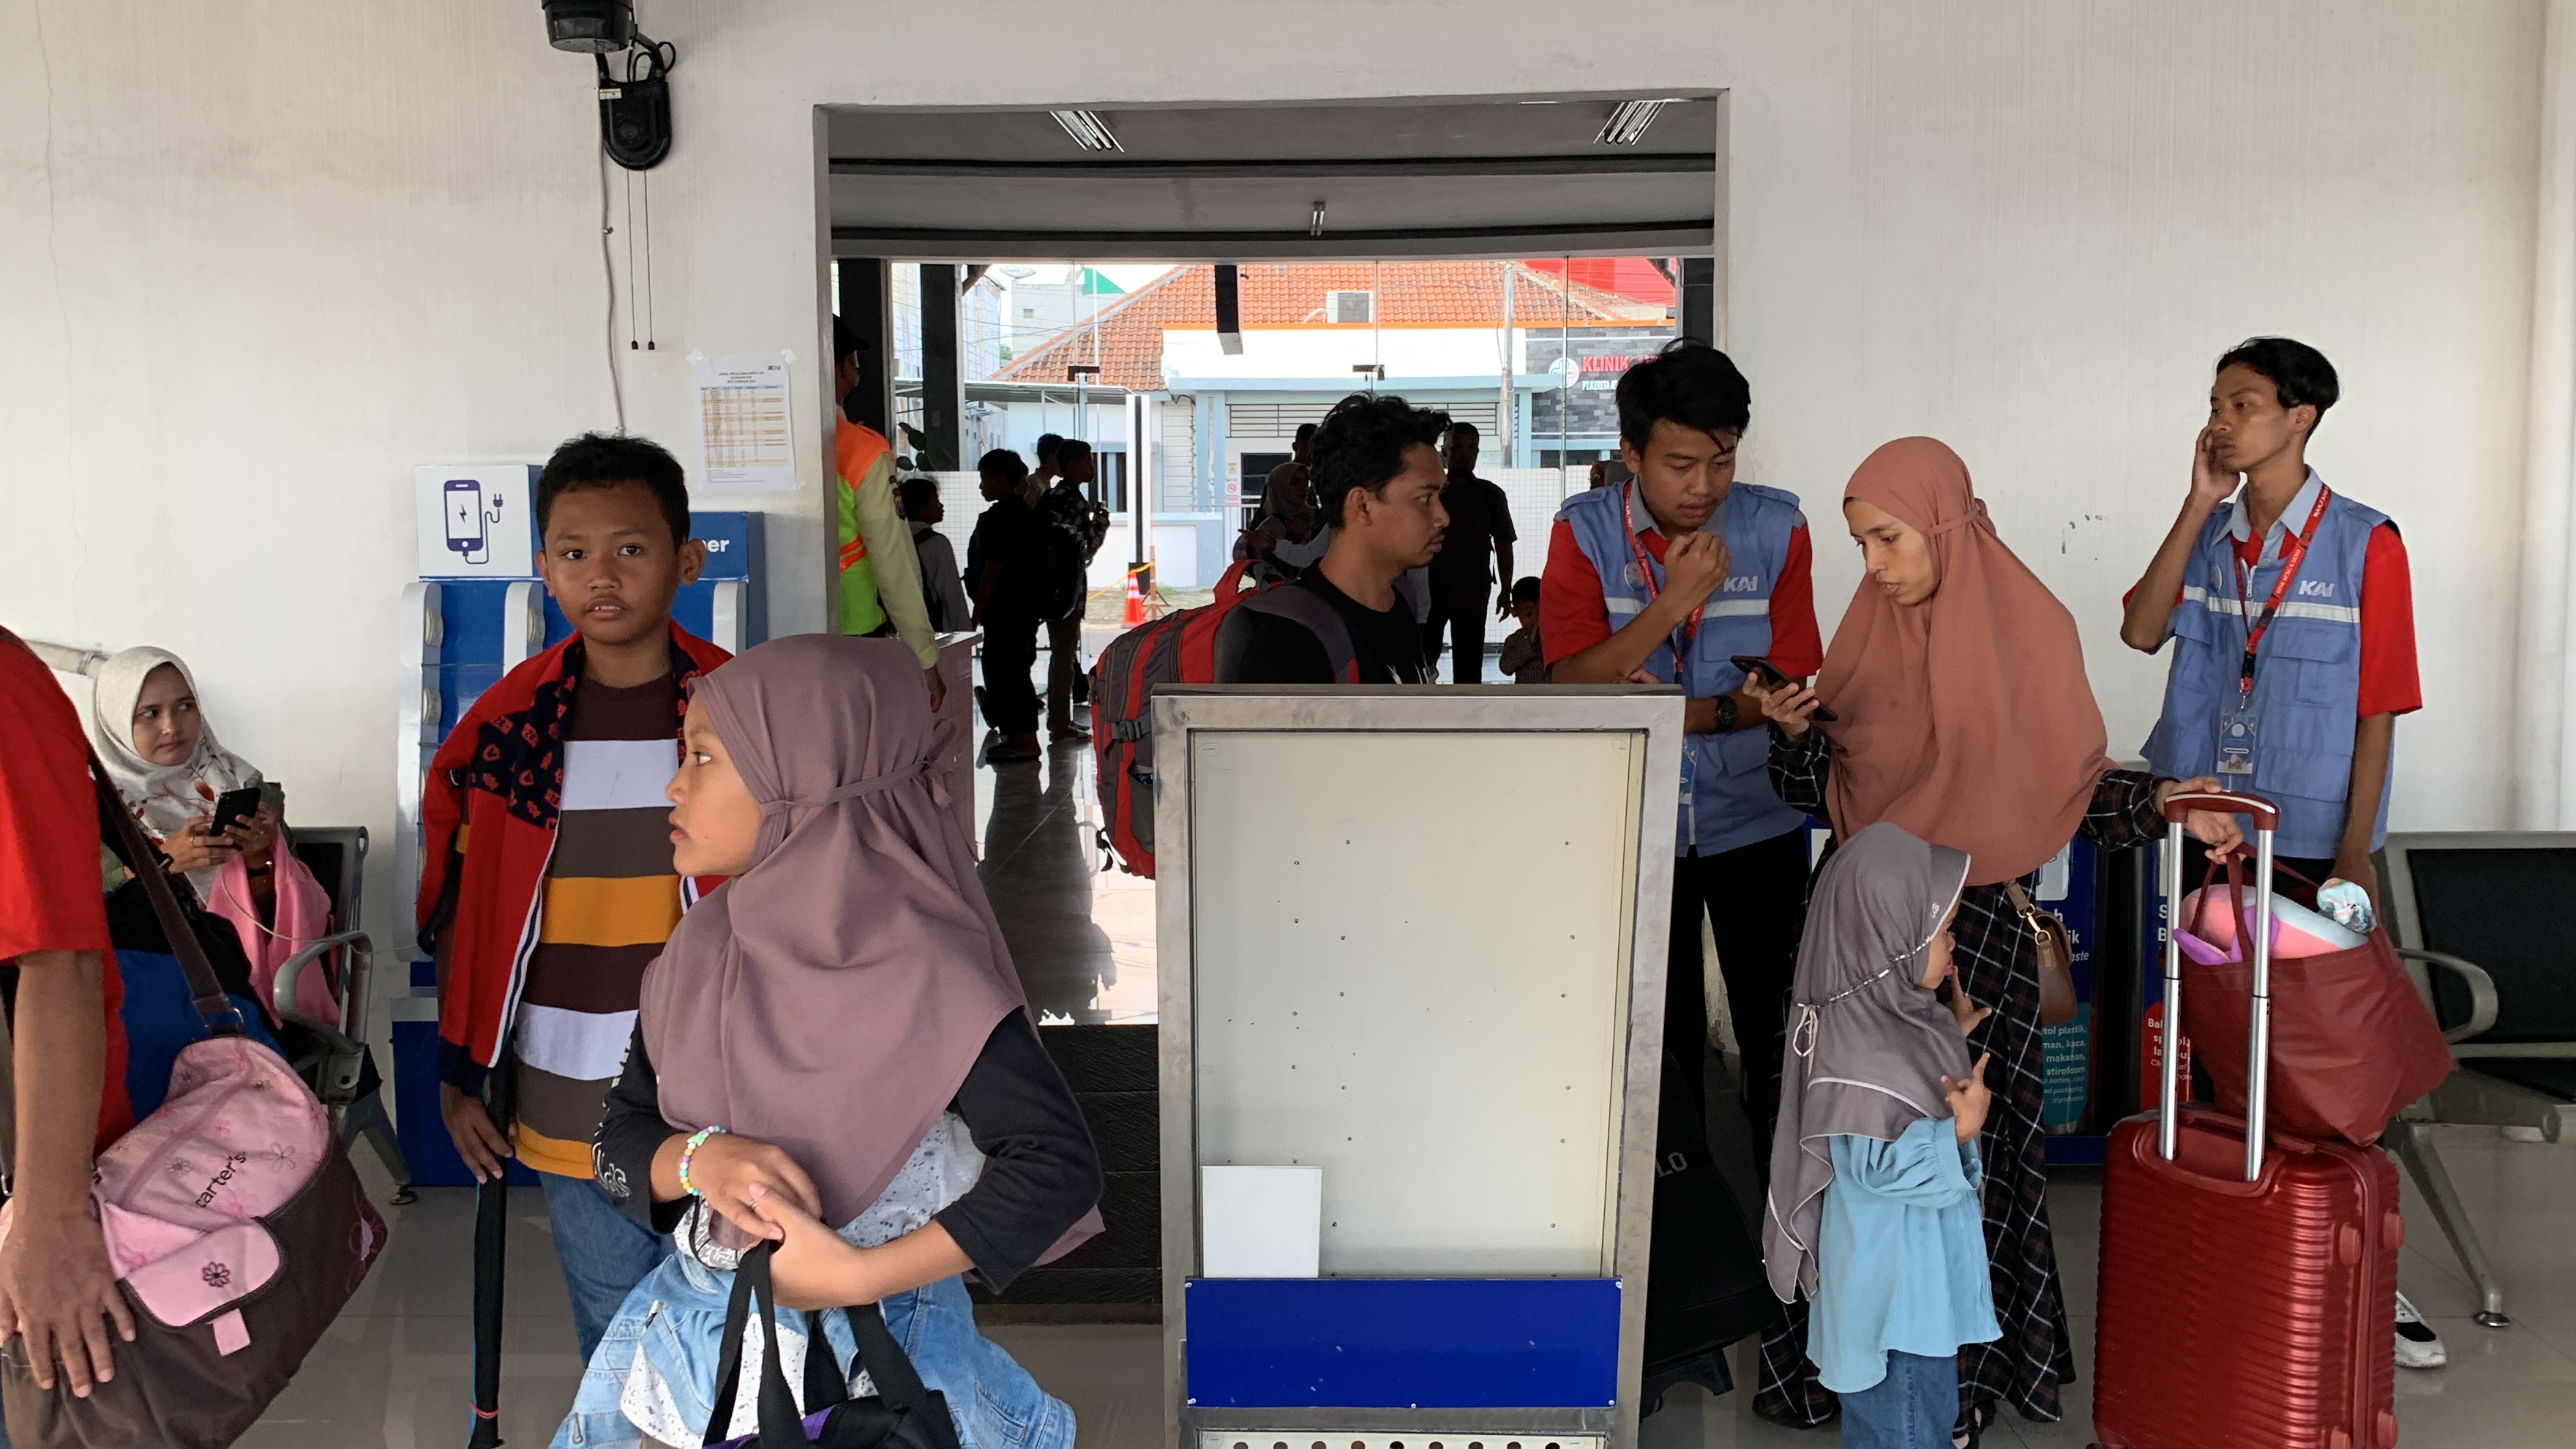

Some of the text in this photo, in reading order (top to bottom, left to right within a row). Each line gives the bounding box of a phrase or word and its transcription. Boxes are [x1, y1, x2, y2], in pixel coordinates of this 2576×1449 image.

[1581, 356, 1629, 372] KLINIK
[1723, 575, 1758, 593] KAI
[2299, 580, 2334, 598] KAI
